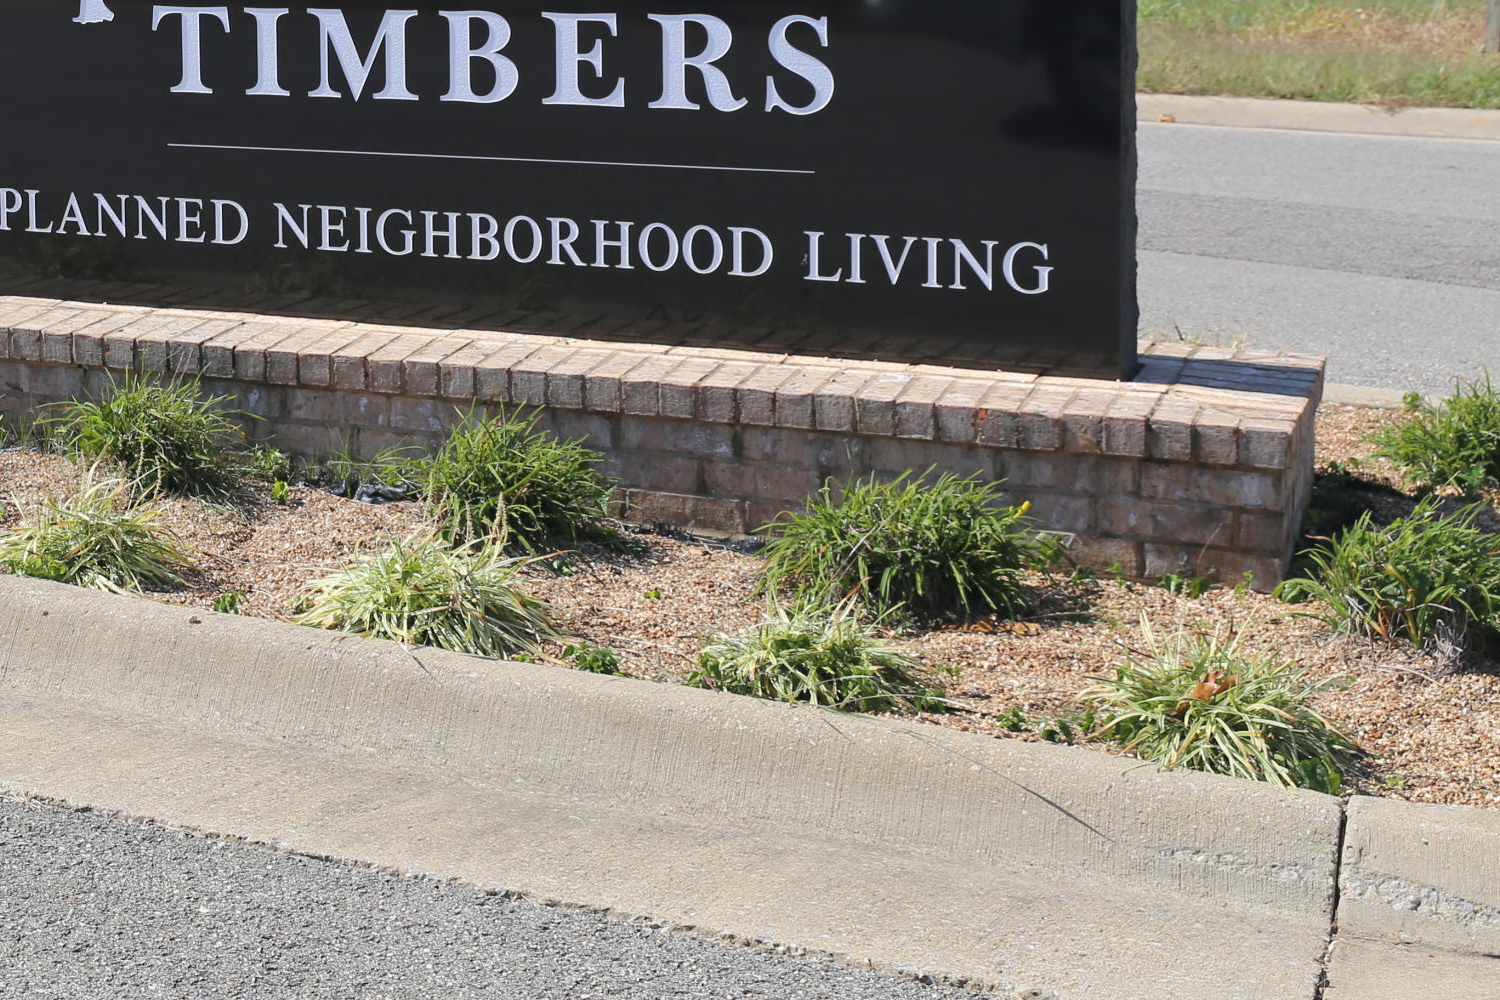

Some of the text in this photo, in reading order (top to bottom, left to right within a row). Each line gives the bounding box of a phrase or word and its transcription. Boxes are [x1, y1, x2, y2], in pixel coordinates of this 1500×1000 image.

[150, 5, 836, 116] TIMBERS
[273, 202, 774, 277] NEIGHBORHOOD
[802, 231, 1055, 295] LIVING
